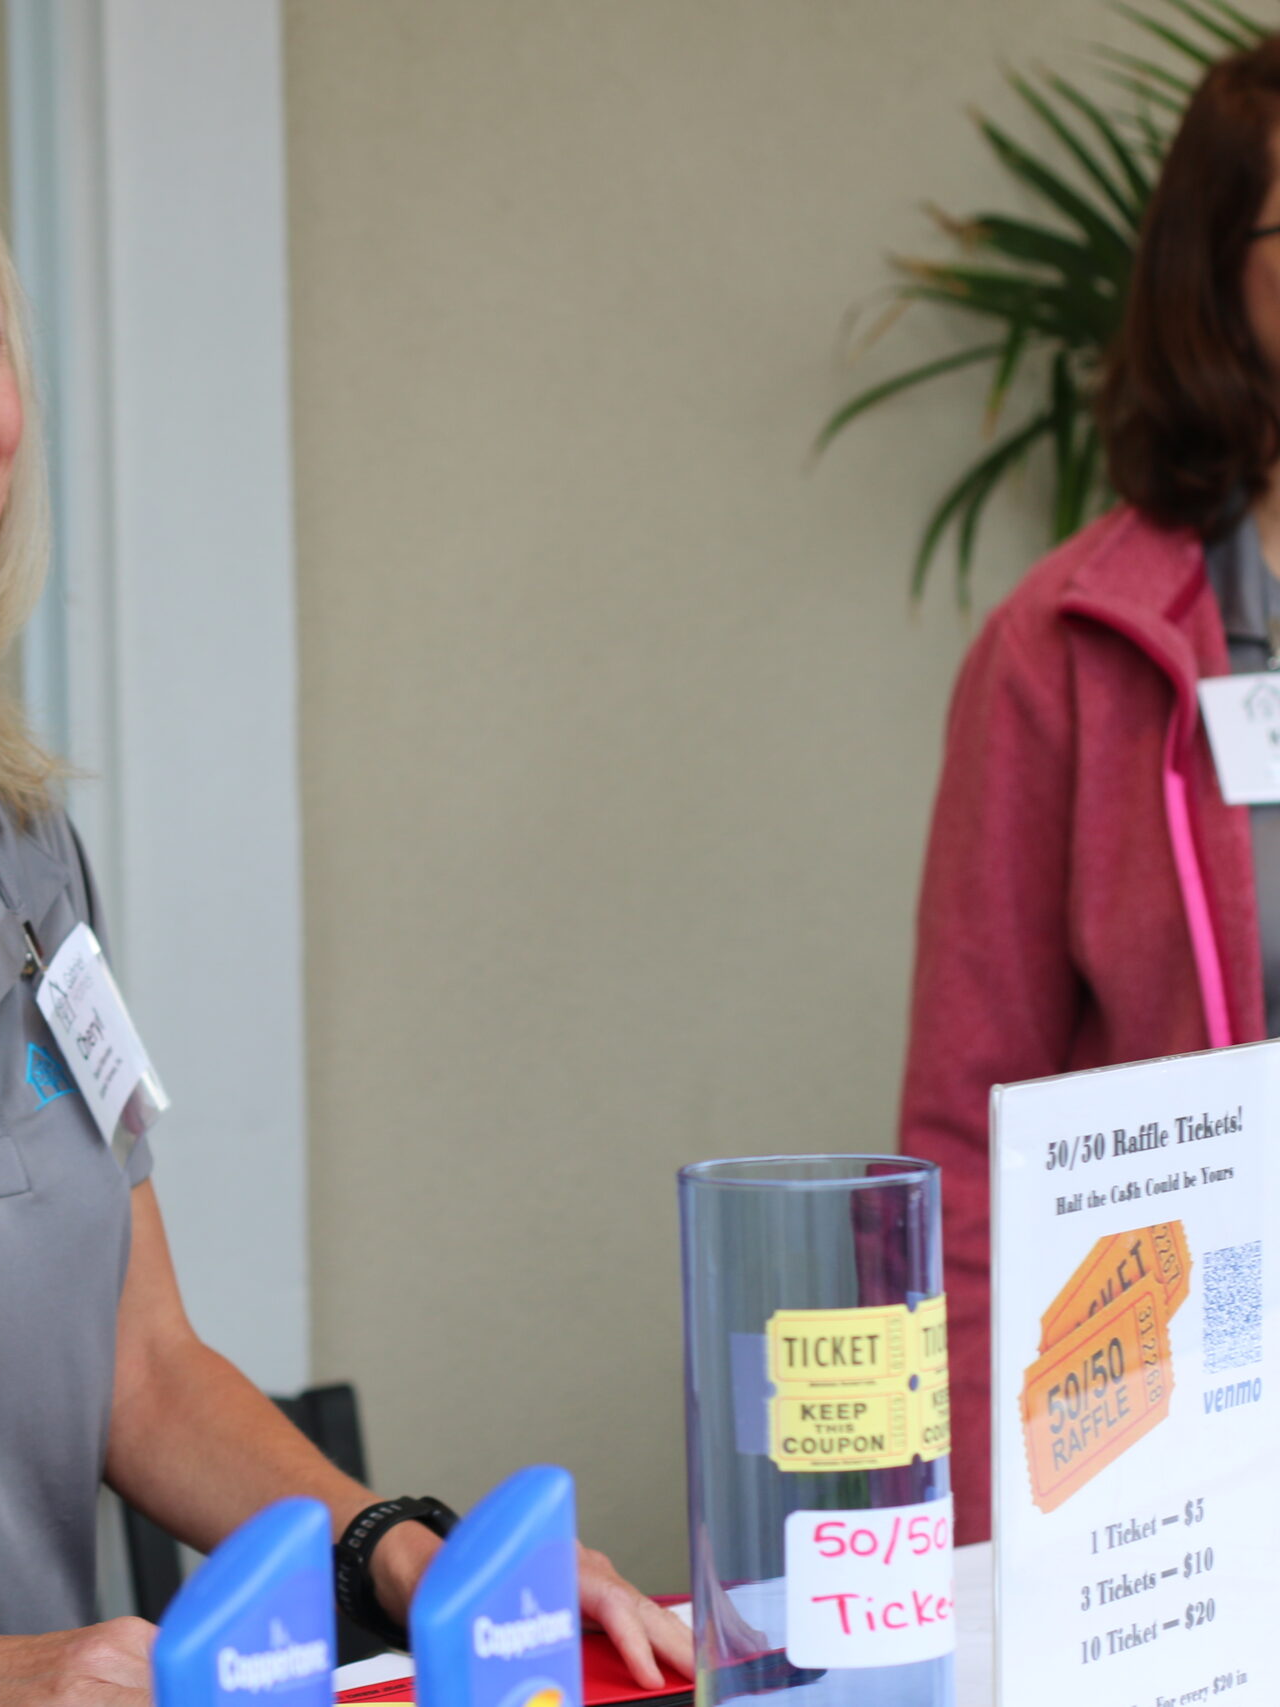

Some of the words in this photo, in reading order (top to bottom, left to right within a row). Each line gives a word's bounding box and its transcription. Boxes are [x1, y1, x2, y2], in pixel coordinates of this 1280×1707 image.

[1045, 1132, 1105, 1171] 50/50
[1112, 1121, 1169, 1157] Raffle
[1175, 1105, 1243, 1144] Tickets!
[1055, 1193, 1083, 1215] Half
[1087, 1189, 1107, 1208] the
[1111, 1181, 1141, 1205] Ca$h
[1145, 1173, 1179, 1198] Could
[1183, 1170, 1197, 1189] be
[1201, 1166, 1235, 1187] Yours
[781, 1334, 880, 1368] TICKET
[1047, 1336, 1126, 1435] 50/50
[1203, 1376, 1262, 1415] venmo
[800, 1402, 868, 1421] KEEP
[814, 1423, 855, 1434] THIS
[1051, 1385, 1131, 1472] RAFFLE
[782, 1434, 885, 1455] COUPON
[813, 1515, 948, 1565] 50/50
[1090, 1530, 1098, 1555] 1
[1104, 1515, 1157, 1550] Ticket
[1184, 1498, 1204, 1526] $5
[1080, 1586, 1091, 1611] 3
[1097, 1571, 1157, 1606] Tickets
[1183, 1547, 1214, 1579] $10
[811, 1588, 955, 1635] Ticke
[1080, 1635, 1101, 1664] 10
[1106, 1621, 1158, 1656] Ticket
[1184, 1598, 1215, 1630] $20
